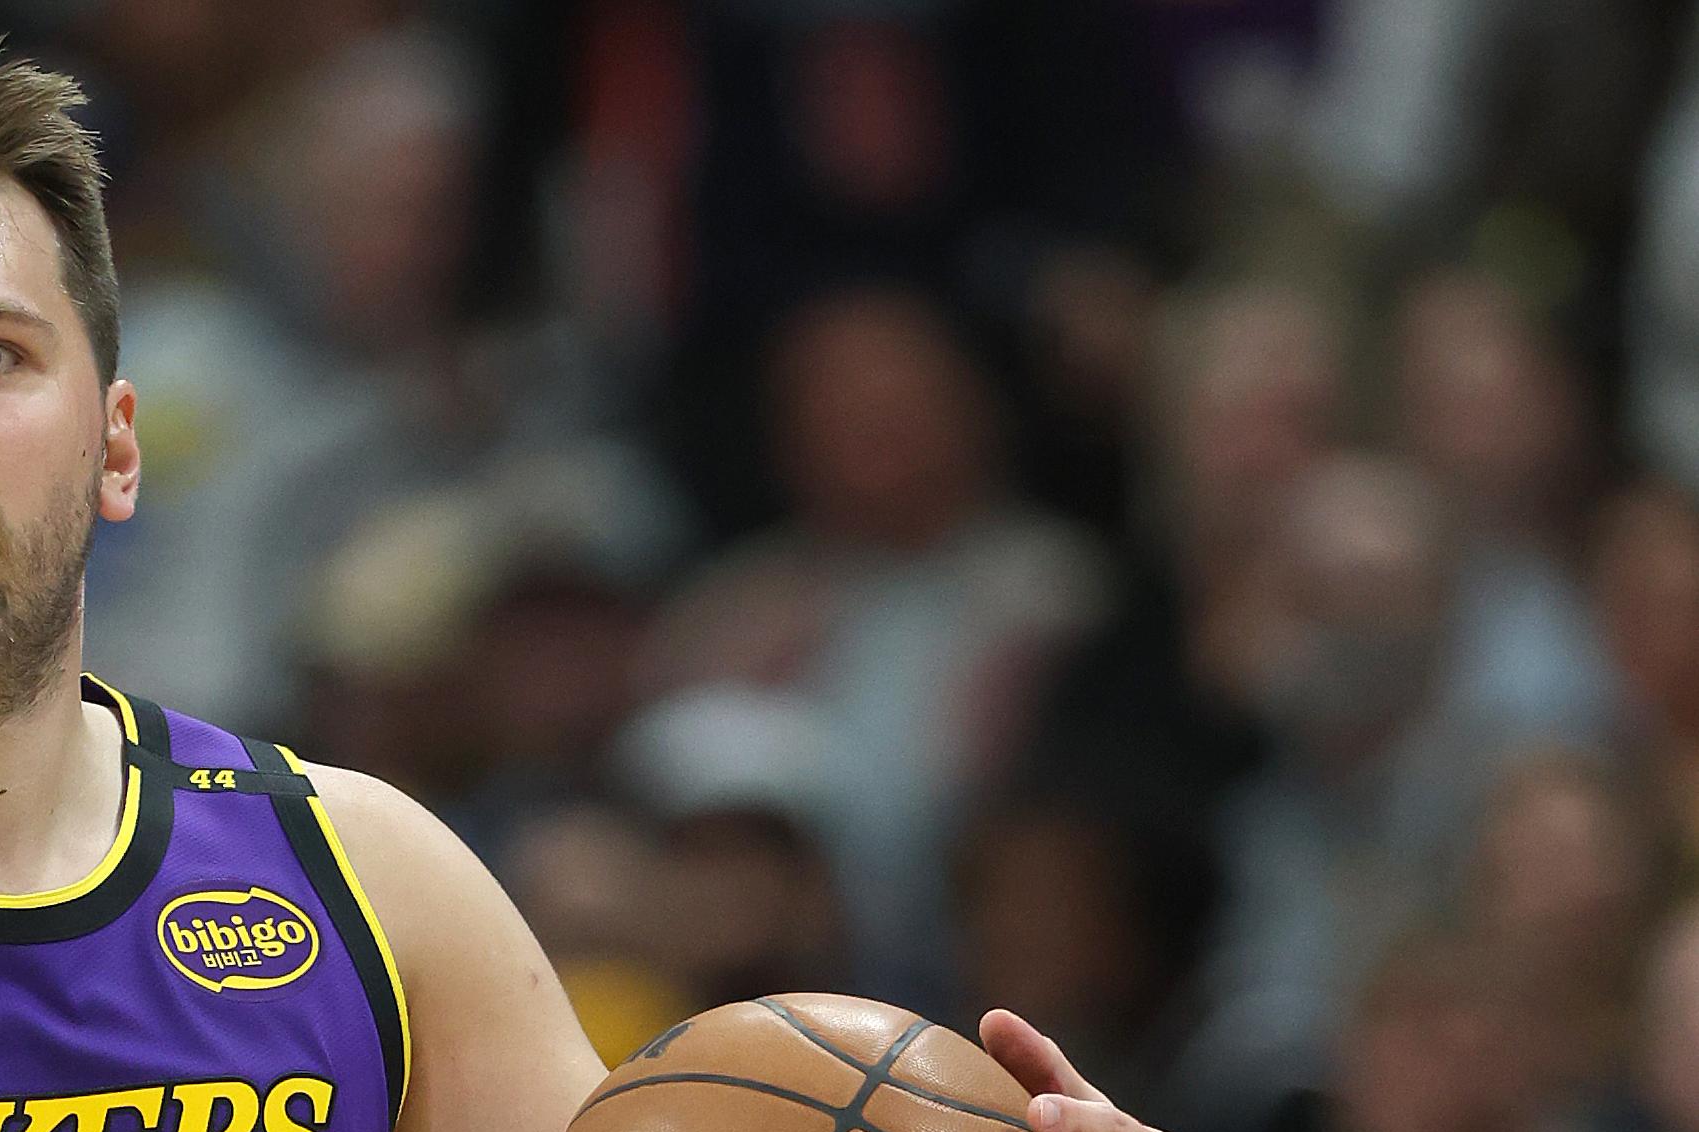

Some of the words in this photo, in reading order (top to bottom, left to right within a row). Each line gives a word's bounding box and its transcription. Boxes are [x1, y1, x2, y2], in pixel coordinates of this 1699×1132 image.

[189, 769, 237, 789] 44
[167, 915, 307, 957] bibigo
[201, 949, 263, 970] 비비고
